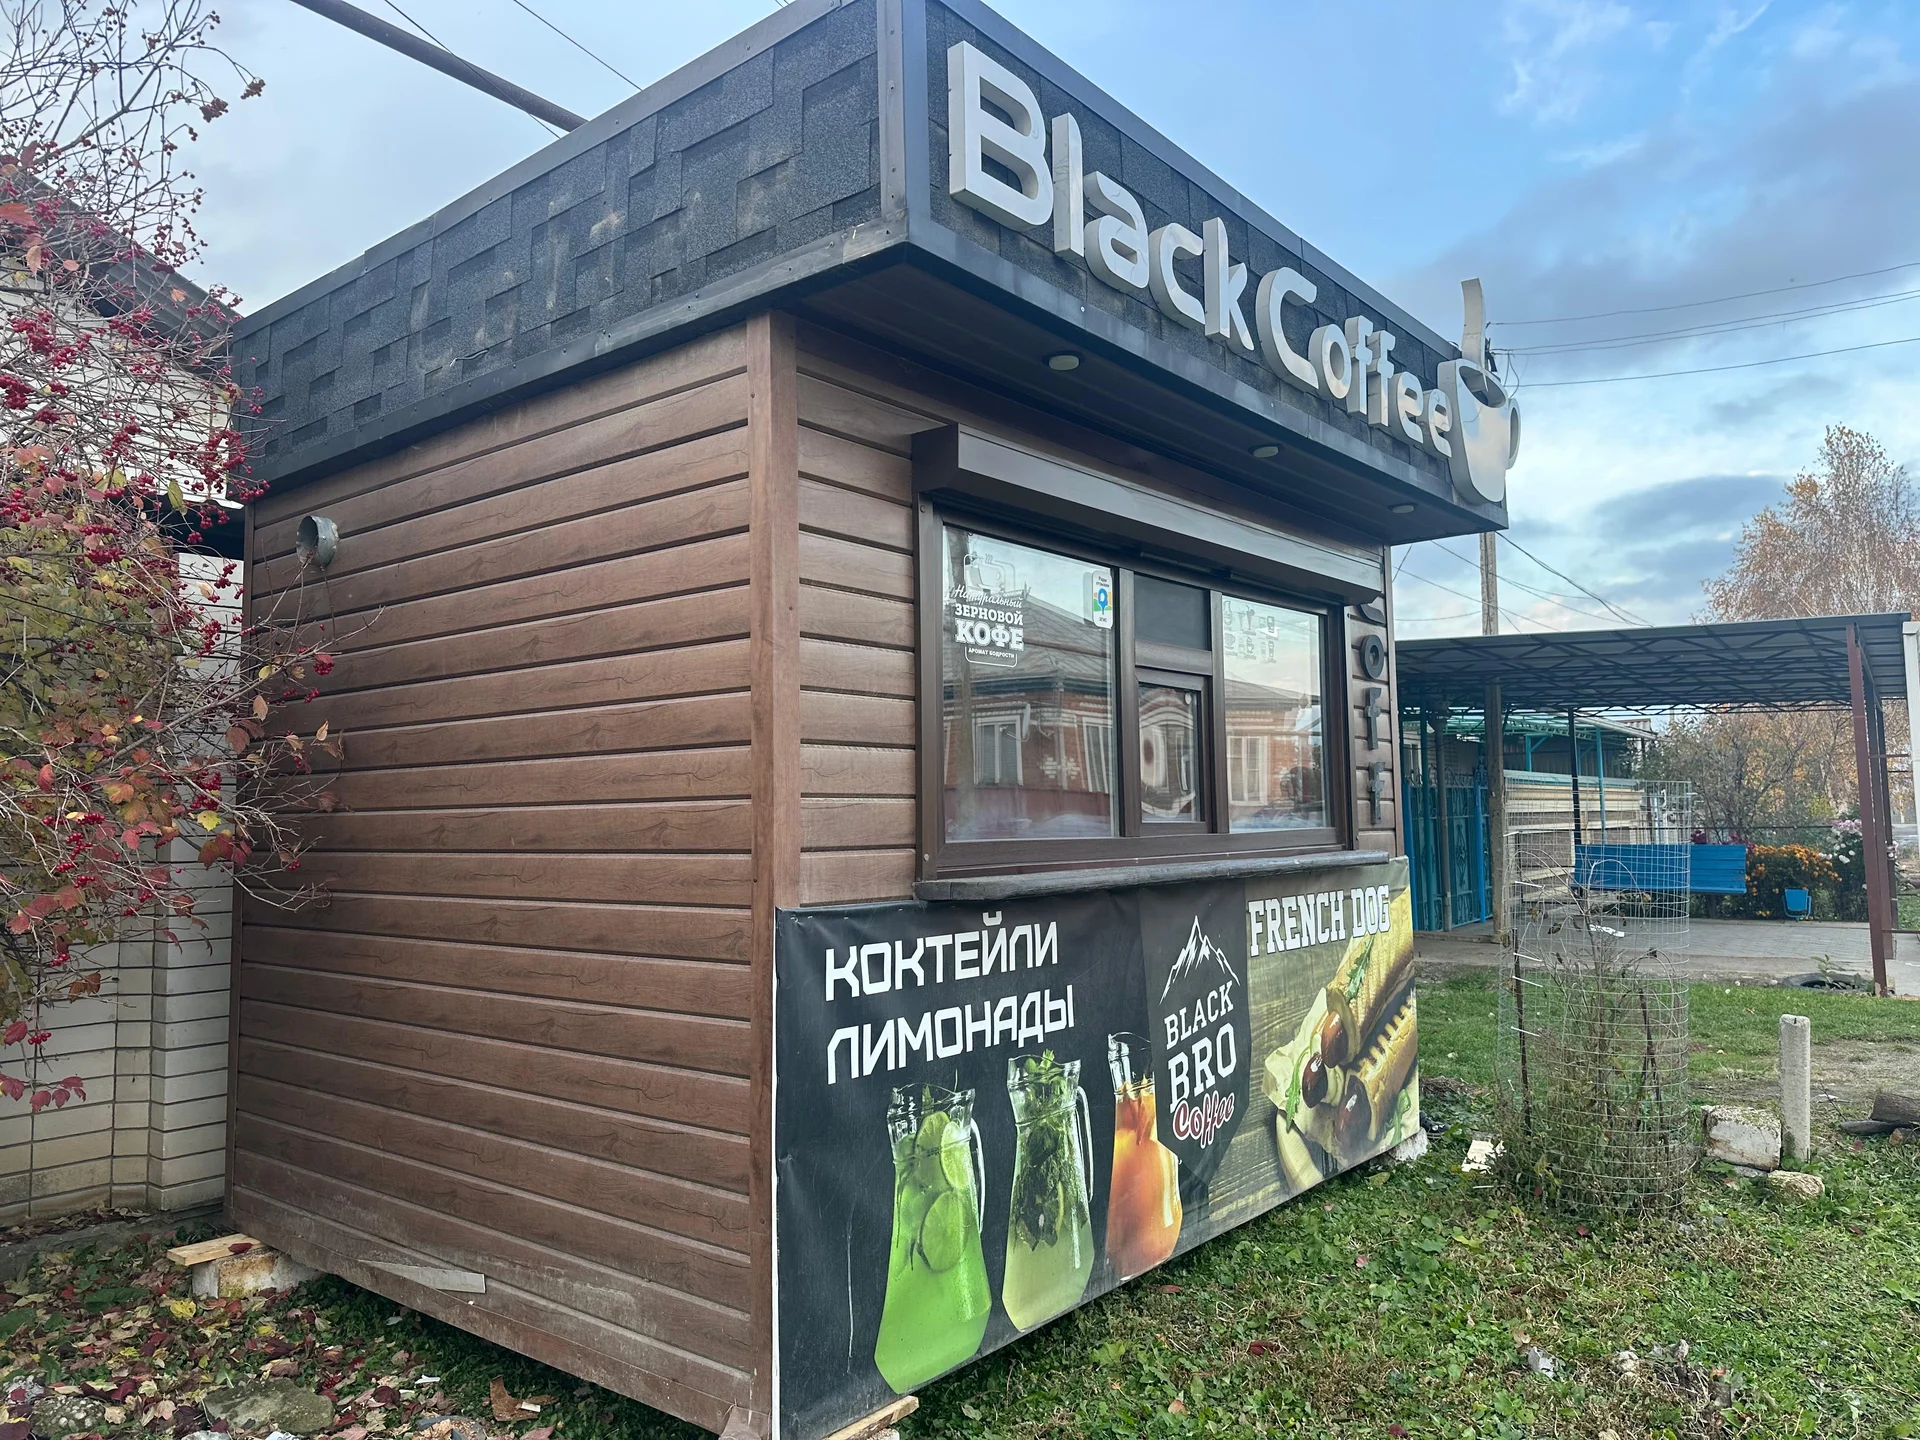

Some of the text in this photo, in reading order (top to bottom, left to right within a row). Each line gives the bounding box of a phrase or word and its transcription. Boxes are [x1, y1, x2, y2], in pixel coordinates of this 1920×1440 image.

[954, 584, 1022, 609] Натуральный
[955, 603, 1023, 626] ЗЕРНОВОЙ
[955, 618, 1024, 652] КОФЕ
[968, 647, 1015, 659] АРОМАТ БОДРОСТИ
[1248, 884, 1392, 957] FRENCH DOG
[825, 910, 1059, 1002] КОКТЕЙЛИ
[826, 984, 1075, 1085] ЛИМОНАДЫ
[1164, 980, 1235, 1051] BLACK
[1168, 1022, 1238, 1114] BRO
[1172, 1090, 1236, 1150] Coffee
